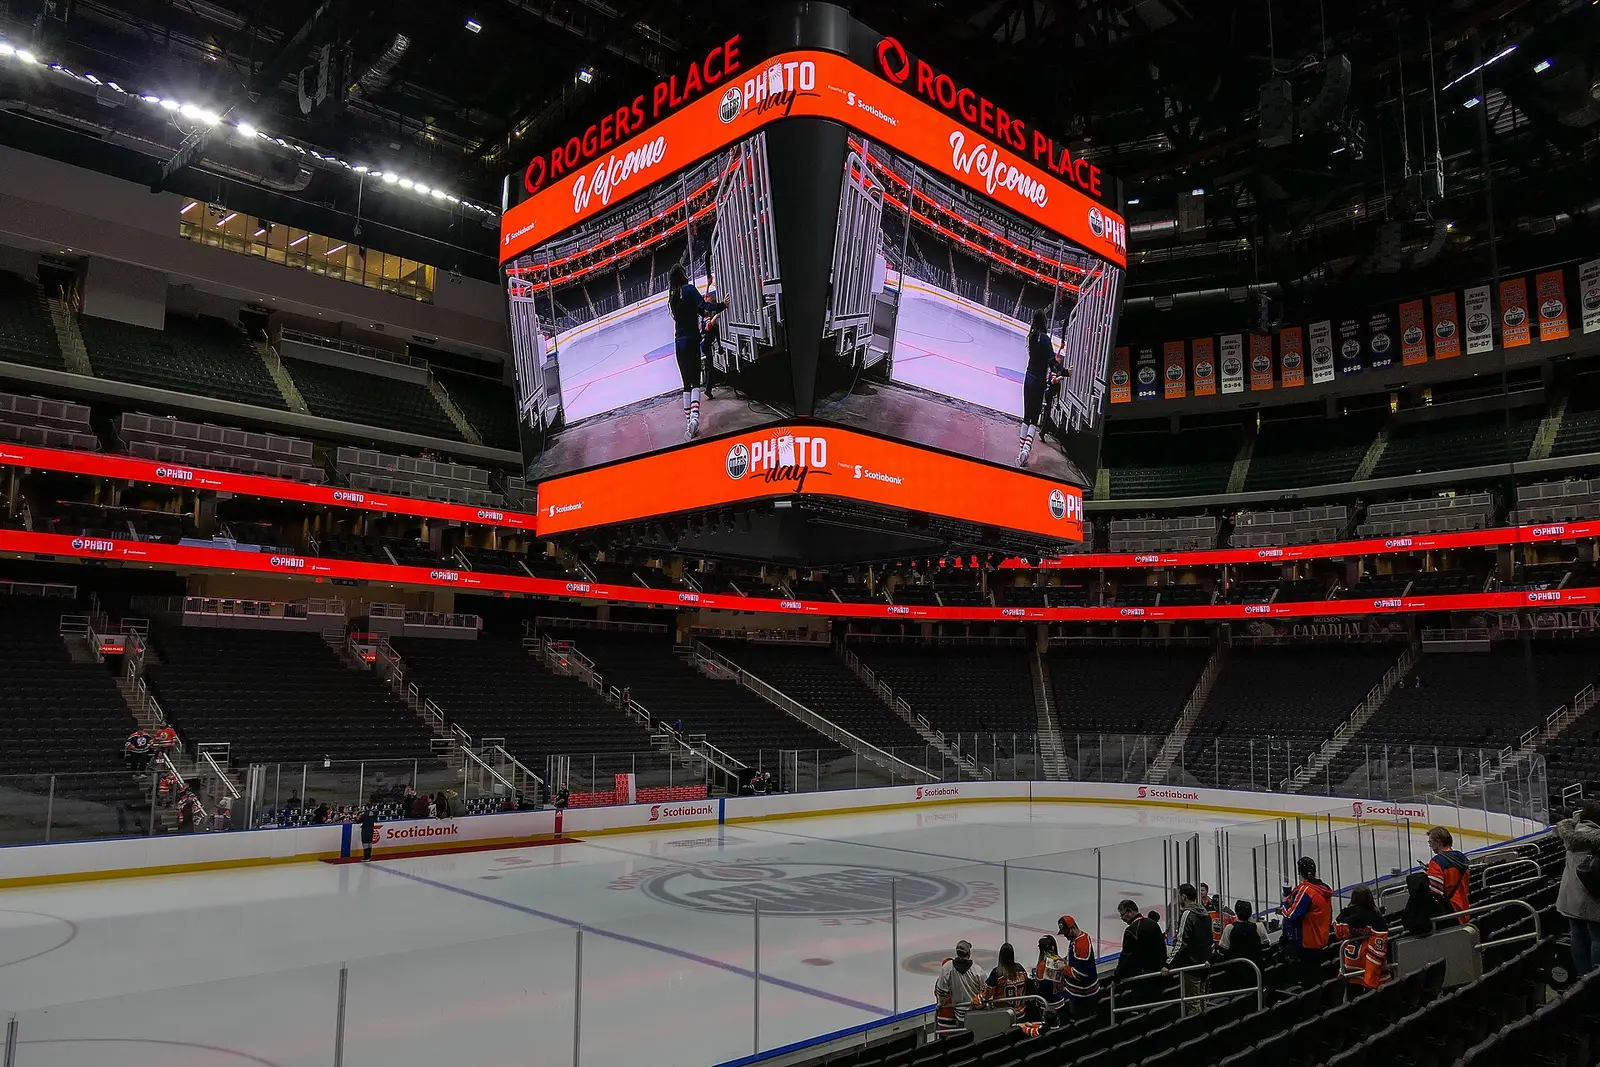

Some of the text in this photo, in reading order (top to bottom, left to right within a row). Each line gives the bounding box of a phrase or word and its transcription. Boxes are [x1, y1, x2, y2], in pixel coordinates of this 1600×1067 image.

[550, 34, 743, 178] ROGERS PLACE
[857, 99, 897, 126] Scotiabank
[917, 59, 1102, 197] ROGERS PLACE
[572, 135, 668, 213] Welcome
[949, 130, 1049, 208] Welcome
[864, 469, 902, 485] Scotiabank
[556, 502, 583, 513] Scotiabank
[1292, 622, 1361, 637] CANADIAN
[924, 787, 959, 797] Scotiabank
[1150, 788, 1199, 801] Scotiabank
[662, 805, 714, 818] Scotiabank
[386, 824, 459, 840] Scotiabank
